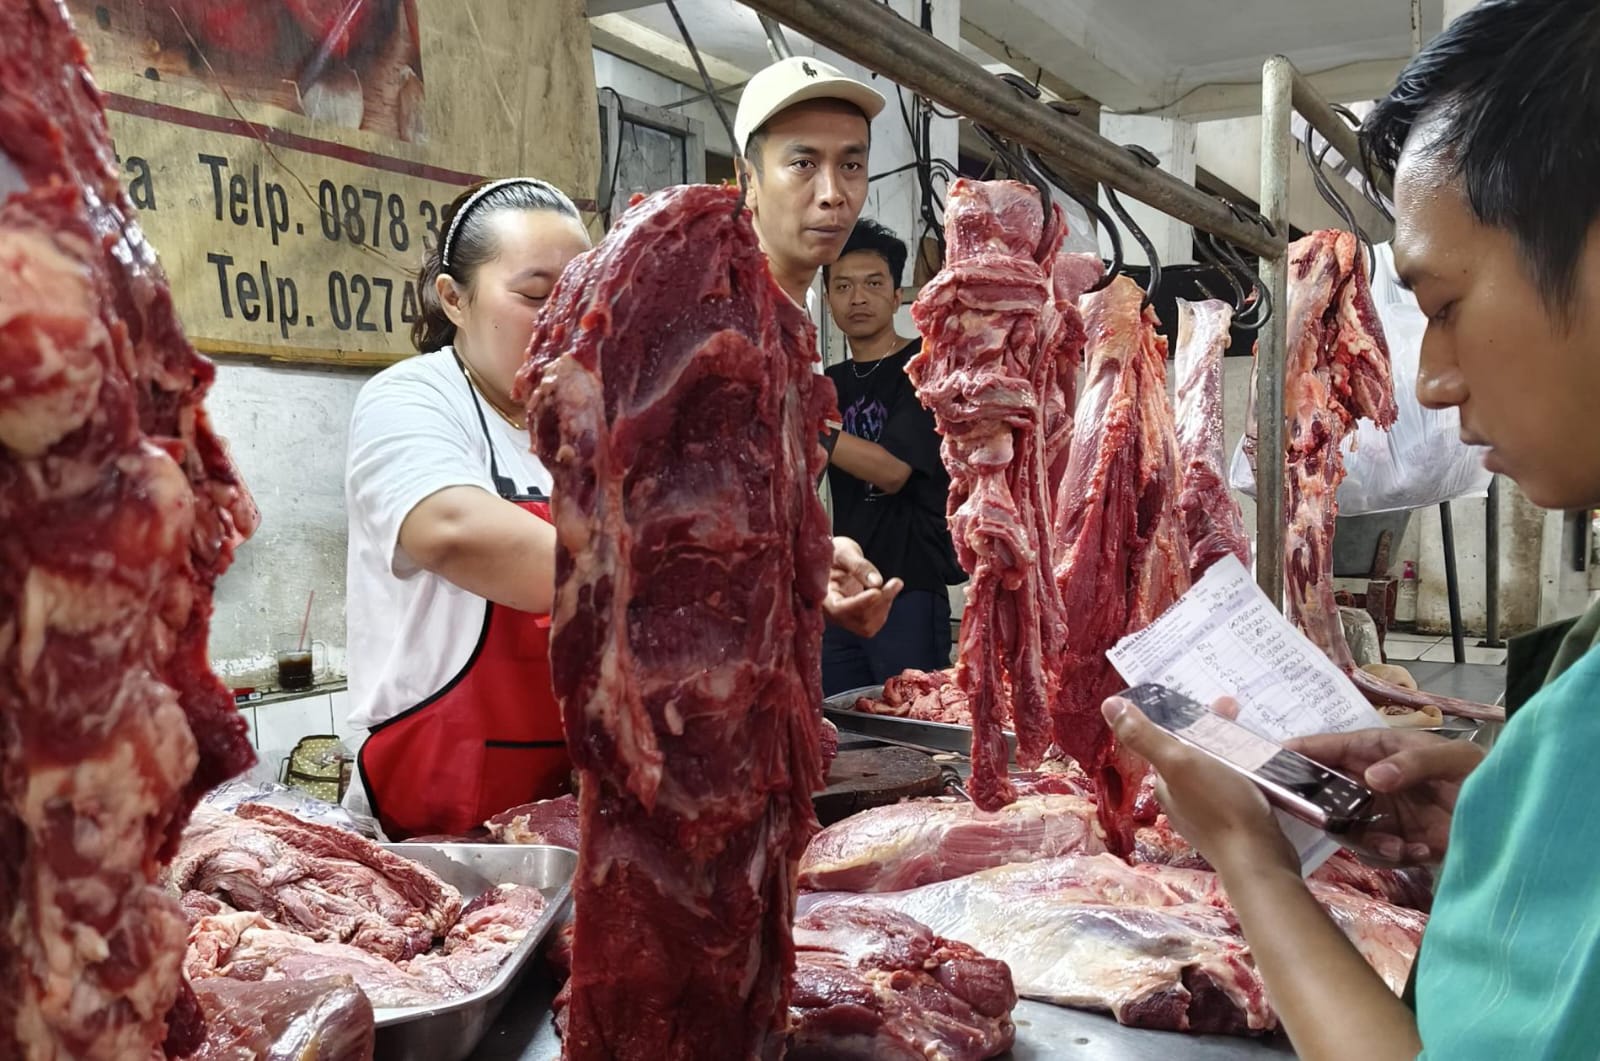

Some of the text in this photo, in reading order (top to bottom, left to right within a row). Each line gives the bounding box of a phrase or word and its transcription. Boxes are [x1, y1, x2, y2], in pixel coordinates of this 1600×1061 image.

[113, 140, 157, 211] a
[199, 153, 305, 246] Telp.
[318, 178, 410, 253] 0878
[207, 253, 423, 339] Telp. 0274
